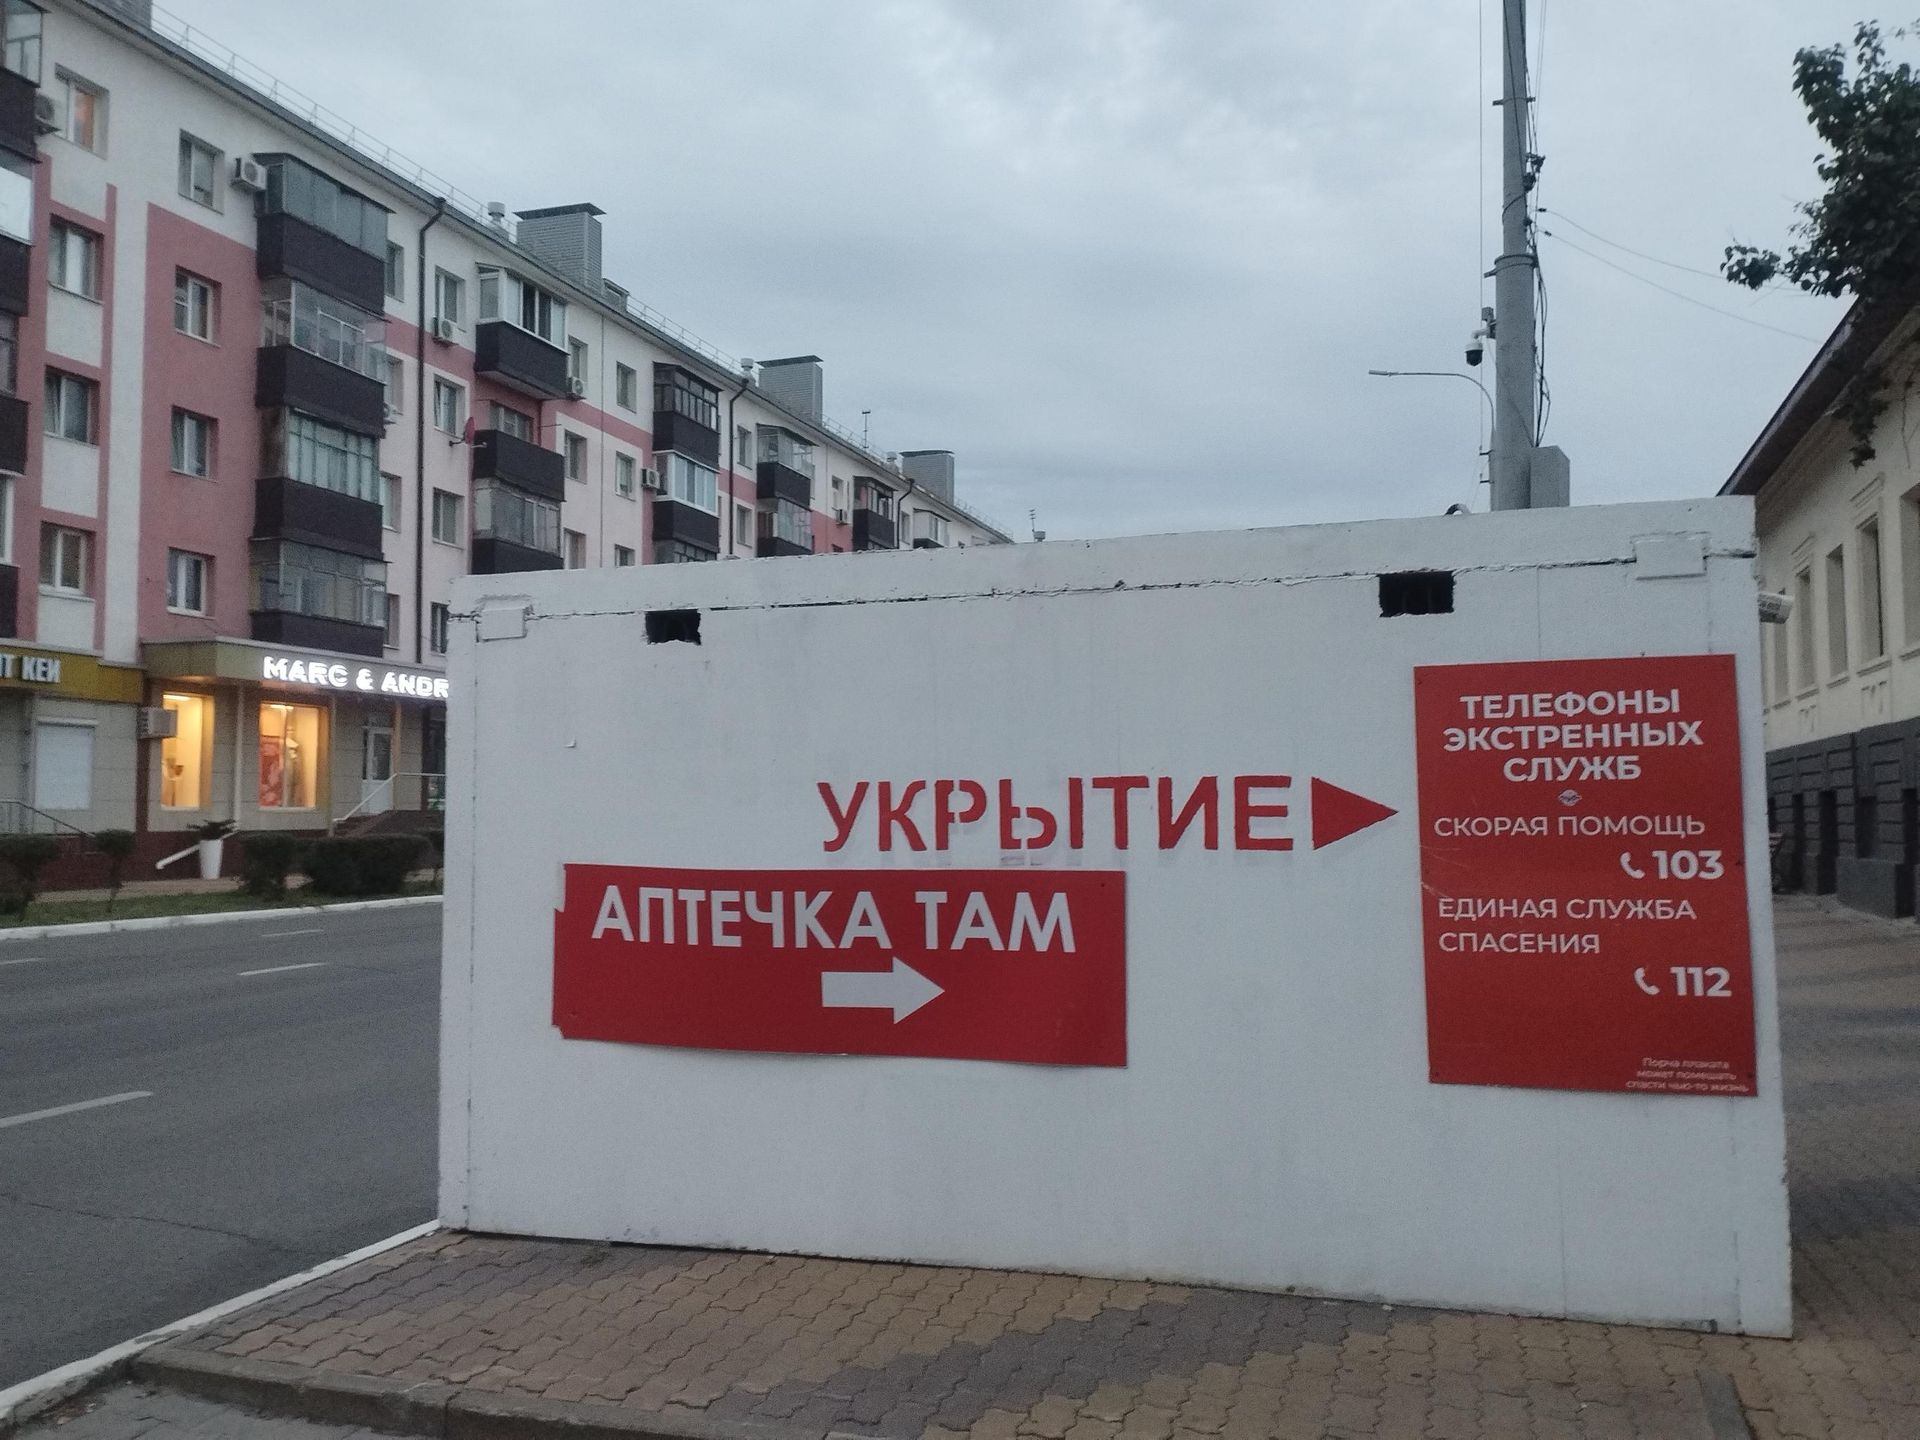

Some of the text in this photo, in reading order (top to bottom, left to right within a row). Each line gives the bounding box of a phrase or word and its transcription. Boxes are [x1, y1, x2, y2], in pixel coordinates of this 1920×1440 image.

[262, 655, 349, 688] MARC
[355, 668, 375, 691] &
[1459, 688, 1681, 719] ТЕЛЕФОНЫ
[1443, 720, 1705, 752] ЭКСТРЕННЫХ
[1503, 755, 1642, 782] СЛУЖБ
[817, 775, 1293, 853] УКРЫТИЕ
[1433, 815, 1706, 839] СКОРАЯ ПОМОЩЬ
[1651, 849, 1724, 880] 103
[591, 884, 1077, 954] АПТЕЧКА ТАМ
[1438, 897, 1698, 922] ЕДИНАЯ СЛУЖБА
[1438, 932, 1600, 954] СПАСЕНИЯ
[1669, 966, 1732, 997] 112
